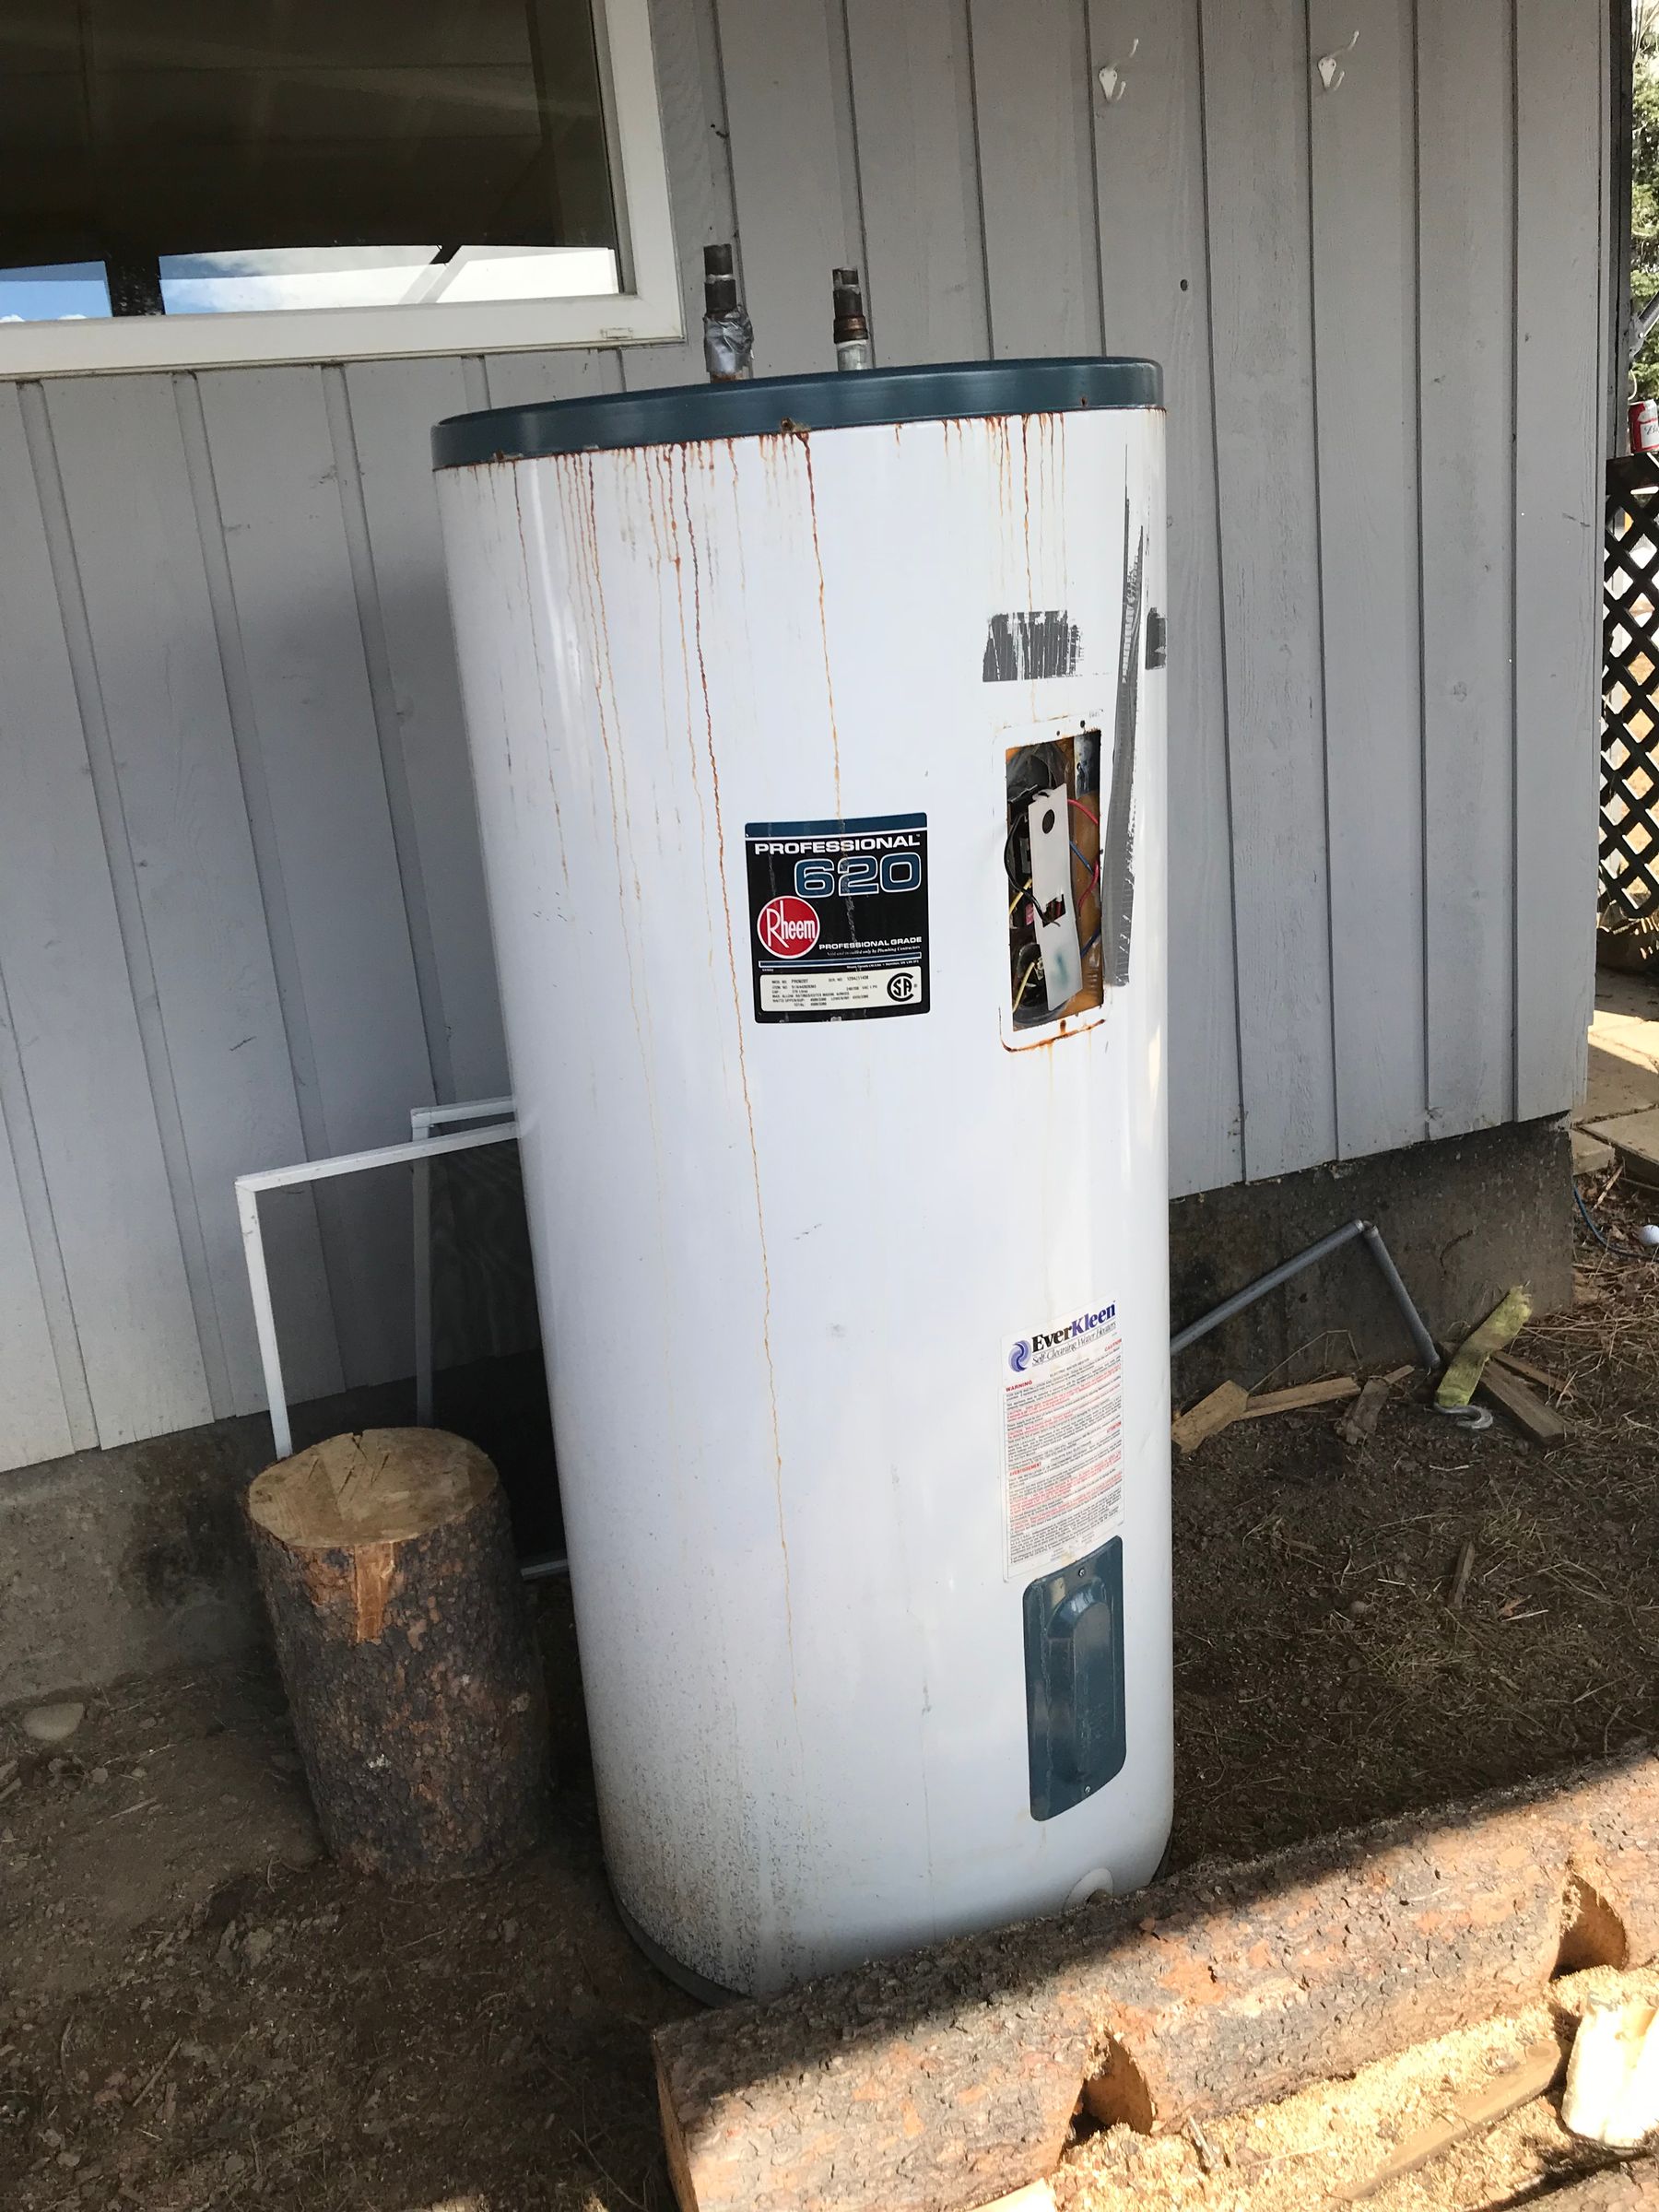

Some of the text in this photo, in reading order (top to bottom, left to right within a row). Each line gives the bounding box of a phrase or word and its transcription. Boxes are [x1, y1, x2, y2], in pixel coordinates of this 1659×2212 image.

[755, 836, 920, 854] PROFESSIONAL
[794, 852, 923, 899] 620
[766, 900, 816, 948] Rheem
[818, 936, 923, 950] PROFESSIONAL GRADE
[887, 972, 914, 1002] CSA
[1031, 1301, 1115, 1354] EverKleen
[1031, 1322, 1117, 1366] Self-Cleaning Water Heaters
[1006, 1380, 1033, 1393] WARNING
